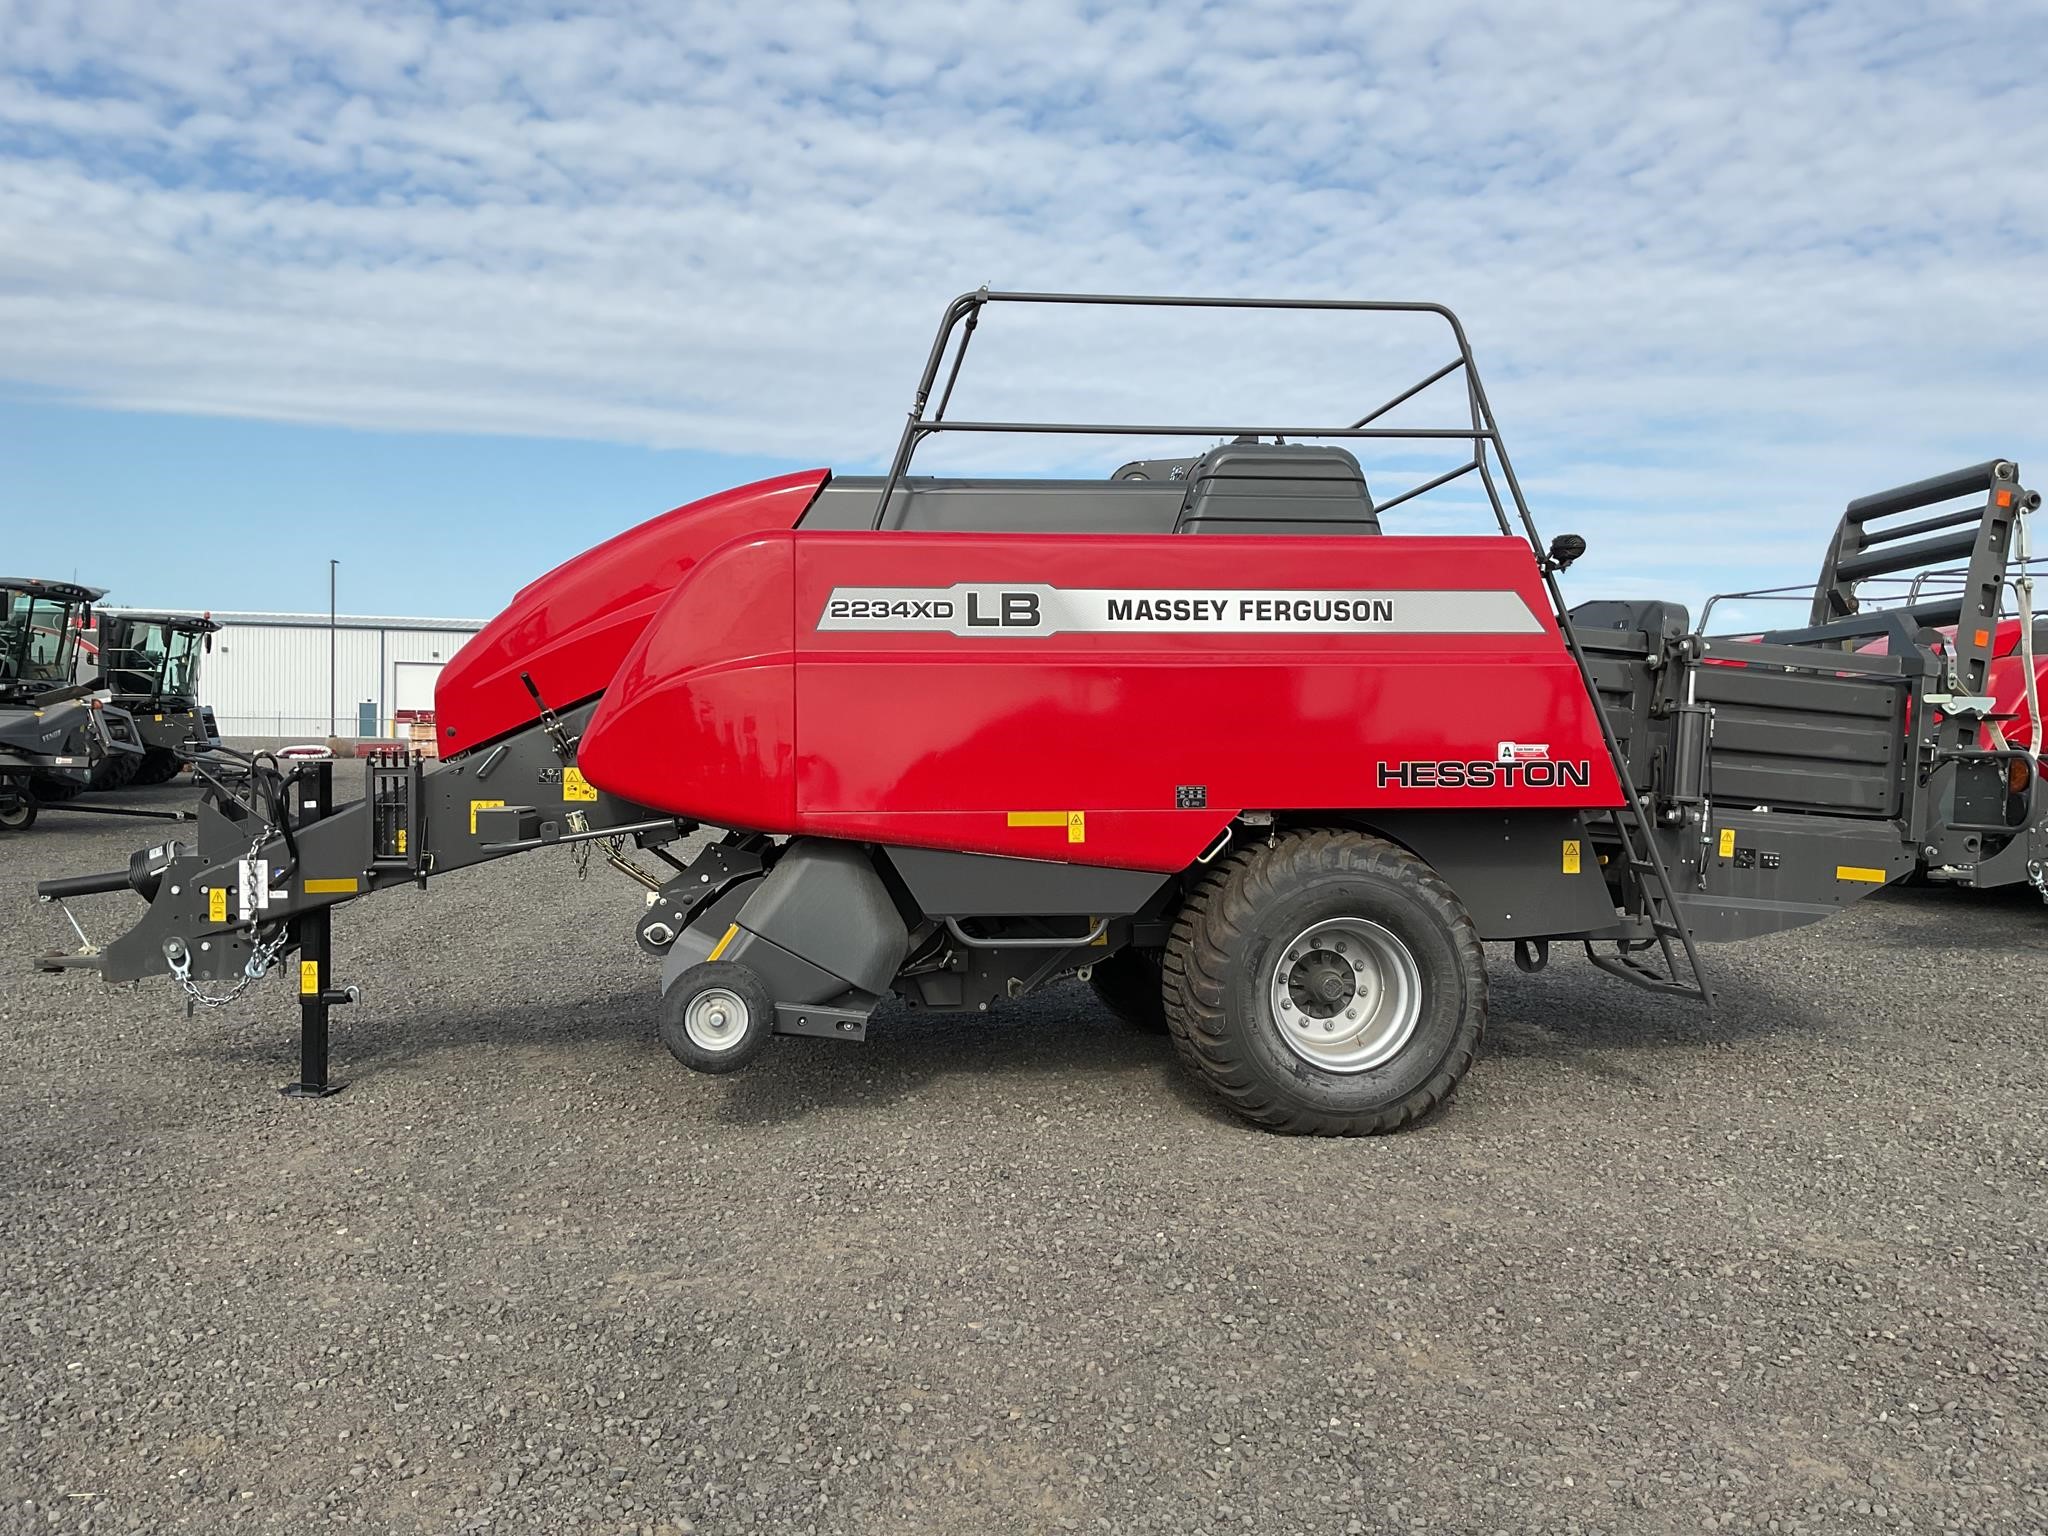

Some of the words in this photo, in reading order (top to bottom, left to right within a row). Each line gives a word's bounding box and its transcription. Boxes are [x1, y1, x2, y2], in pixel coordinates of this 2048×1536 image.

[830, 600, 954, 619] 2234XD
[966, 591, 1041, 627] LB
[1107, 599, 1228, 621] MASSEY
[1239, 599, 1394, 622] FERGUSON
[1377, 760, 1590, 788] HESSTON
